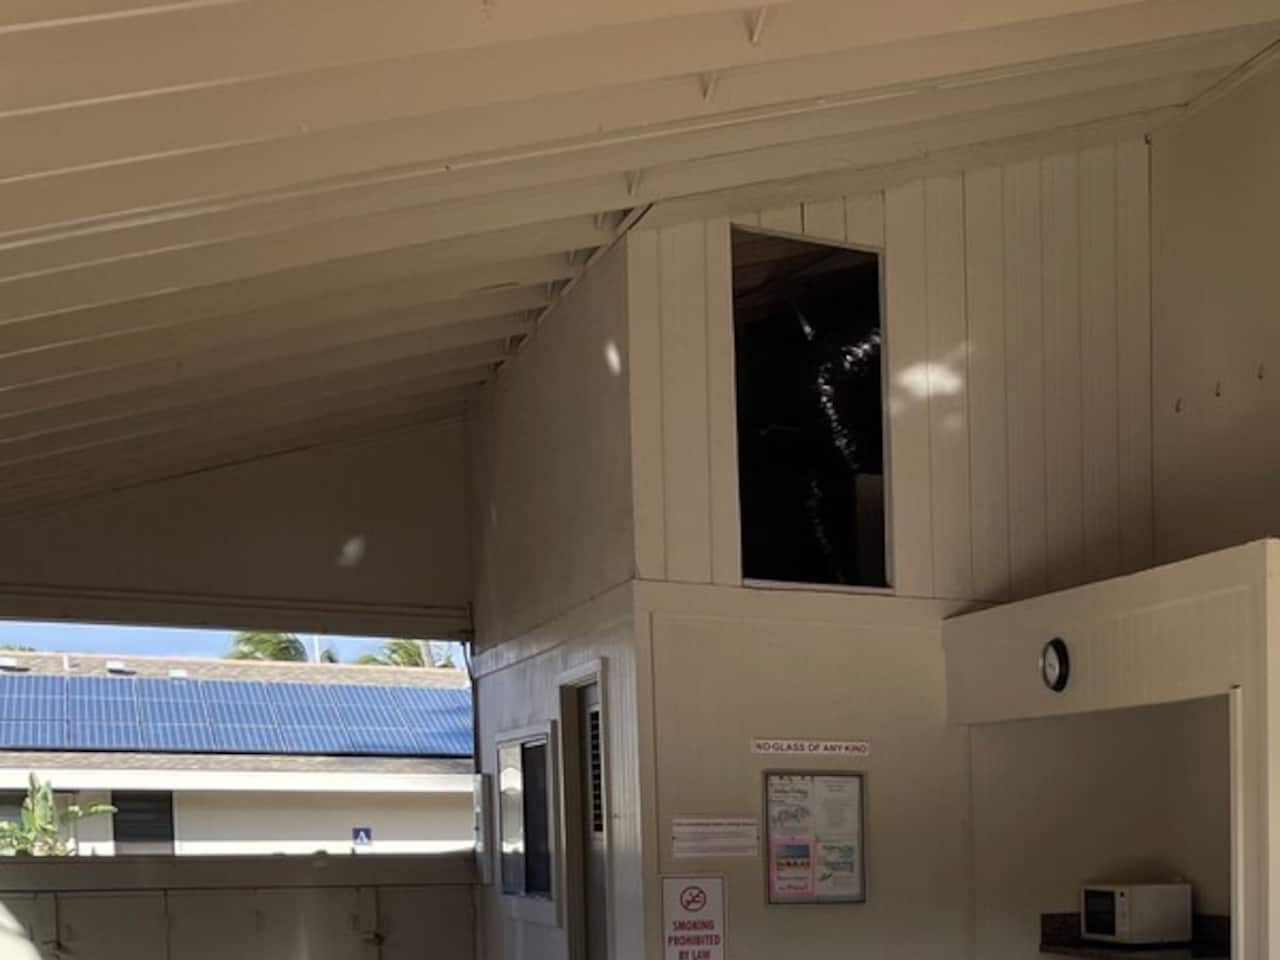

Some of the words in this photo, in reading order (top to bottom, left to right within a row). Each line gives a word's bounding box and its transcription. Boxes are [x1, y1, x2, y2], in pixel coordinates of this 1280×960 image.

[808, 743, 820, 753] OF
[823, 743, 842, 753] ANY
[844, 743, 866, 754] KIND
[672, 920, 714, 931] SMOKING
[668, 935, 721, 946] PROHIBITED
[679, 950, 690, 960] BY
[691, 950, 711, 960] LAW
